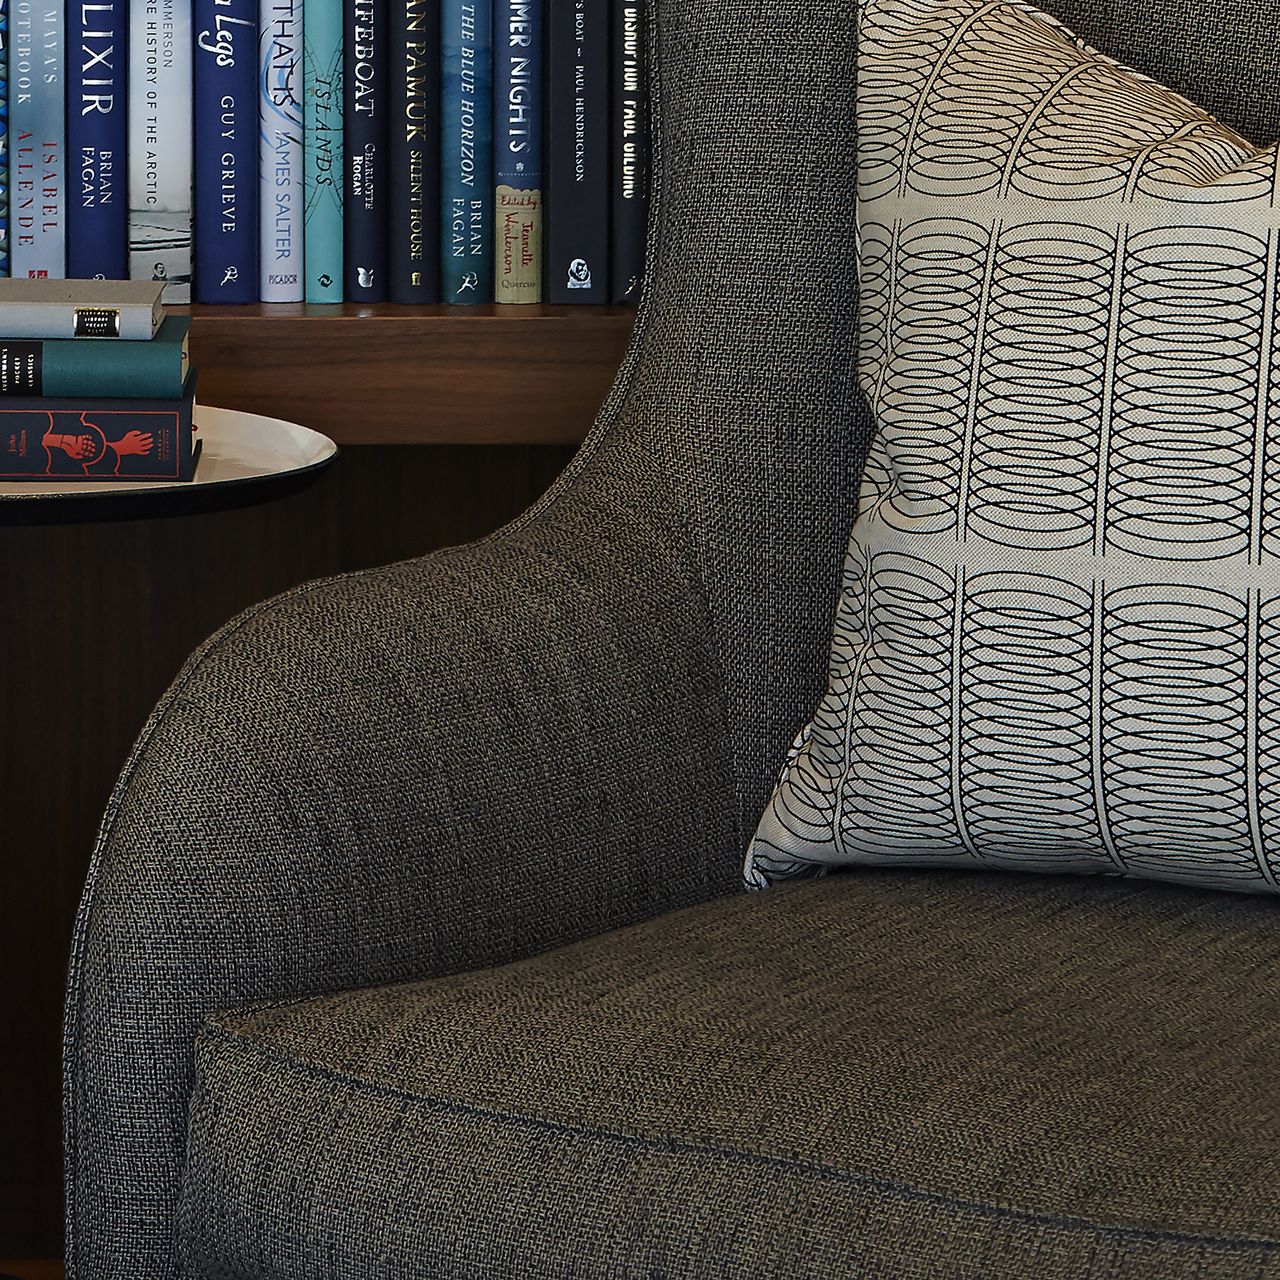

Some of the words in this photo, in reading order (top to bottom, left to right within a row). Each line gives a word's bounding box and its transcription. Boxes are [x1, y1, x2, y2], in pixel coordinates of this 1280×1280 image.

[198, 15, 250, 67] Legs
[461, 5, 474, 41] THE
[146, 22, 157, 84] HISTORY
[461, 46, 476, 93] BLUE
[146, 91, 157, 109] OF
[221, 96, 234, 140] GUY
[406, 42, 426, 142] PAMUK
[509, 57, 530, 152] NIGHTS
[146, 116, 157, 143] THE
[461, 99, 474, 186] HORIZON
[82, 147, 95, 207] FAGAN
[100, 151, 112, 203] BRIAN
[146, 151, 157, 204] ARCTIC
[221, 153, 235, 232] GRIEVE
